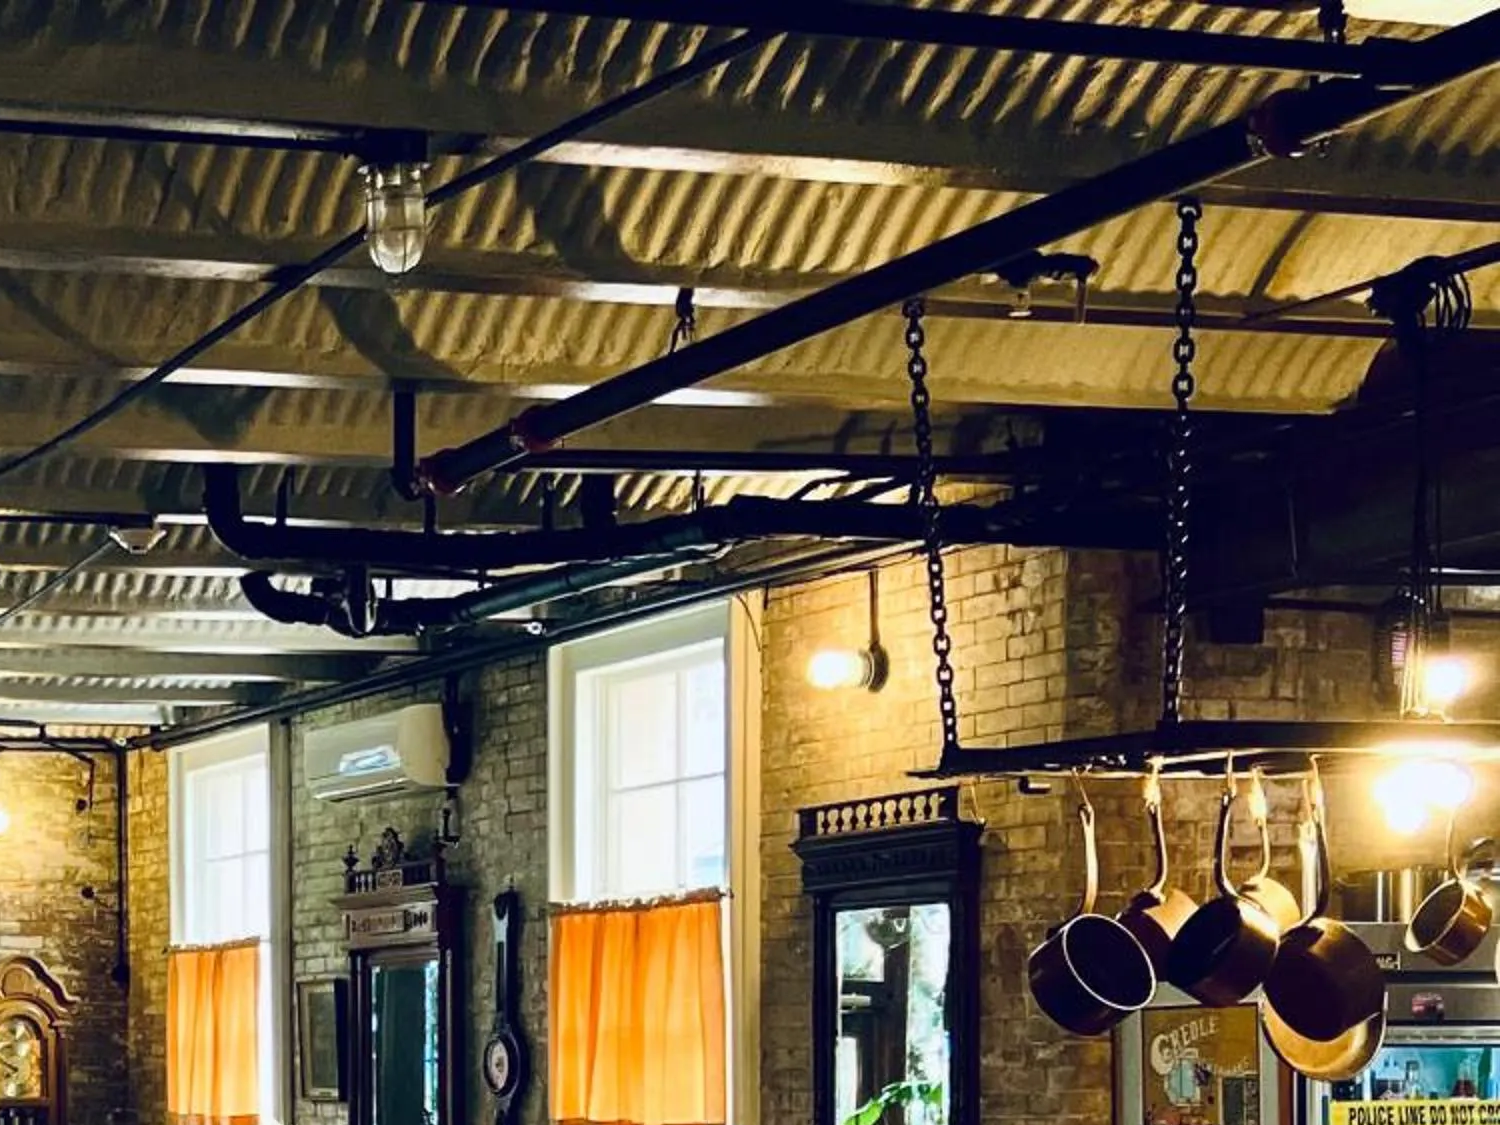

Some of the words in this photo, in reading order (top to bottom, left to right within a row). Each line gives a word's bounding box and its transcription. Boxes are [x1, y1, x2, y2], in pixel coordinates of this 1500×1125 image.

[1150, 1015, 1220, 1076] CREOLE
[1398, 1105, 1426, 1125] LINE
[1429, 1105, 1447, 1125] DO
[1450, 1104, 1475, 1125] NOT
